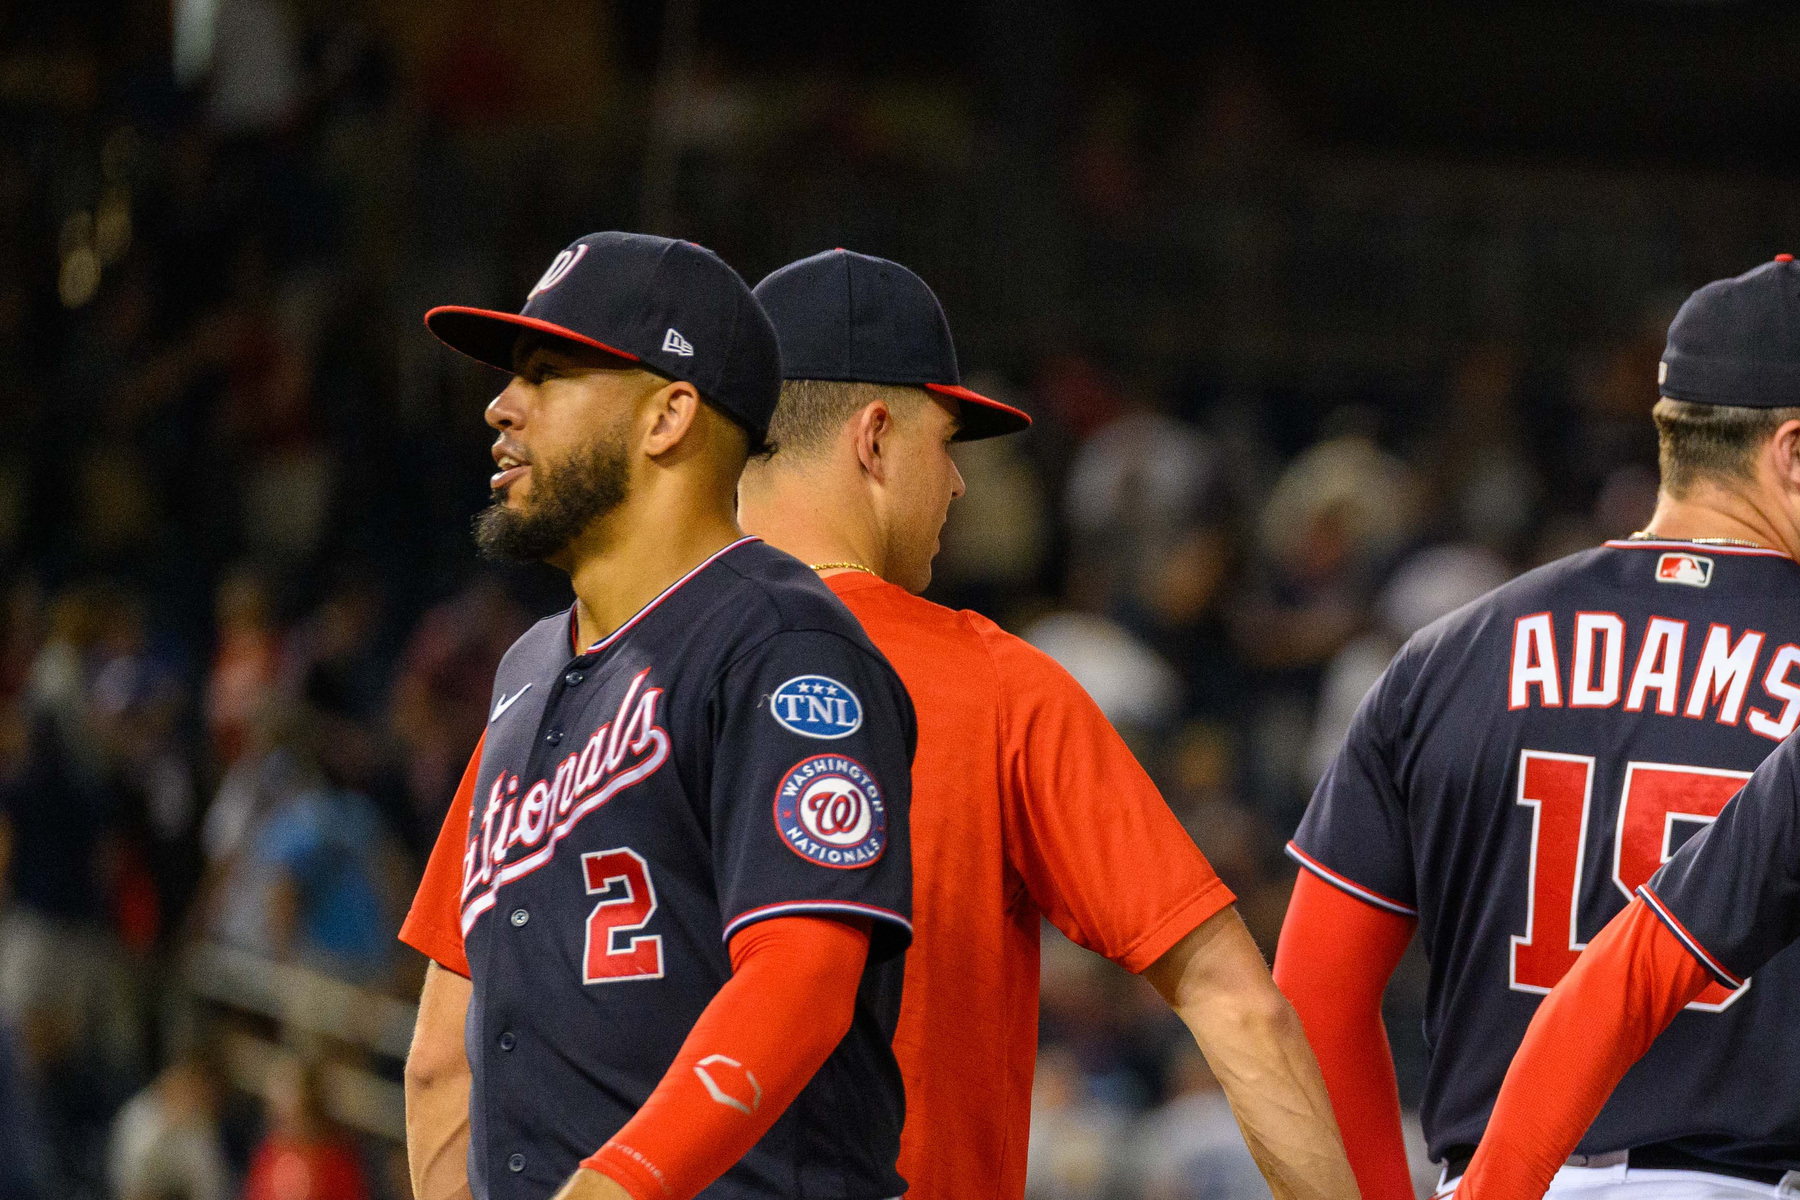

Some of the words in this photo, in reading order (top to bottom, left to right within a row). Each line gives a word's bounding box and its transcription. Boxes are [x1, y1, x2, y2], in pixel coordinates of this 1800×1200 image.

[778, 693, 858, 727] TNL
[782, 758, 885, 813] WASHINGTON
[808, 789, 862, 836] W
[785, 826, 881, 864] NATIONALS
[581, 846, 664, 985] 2
